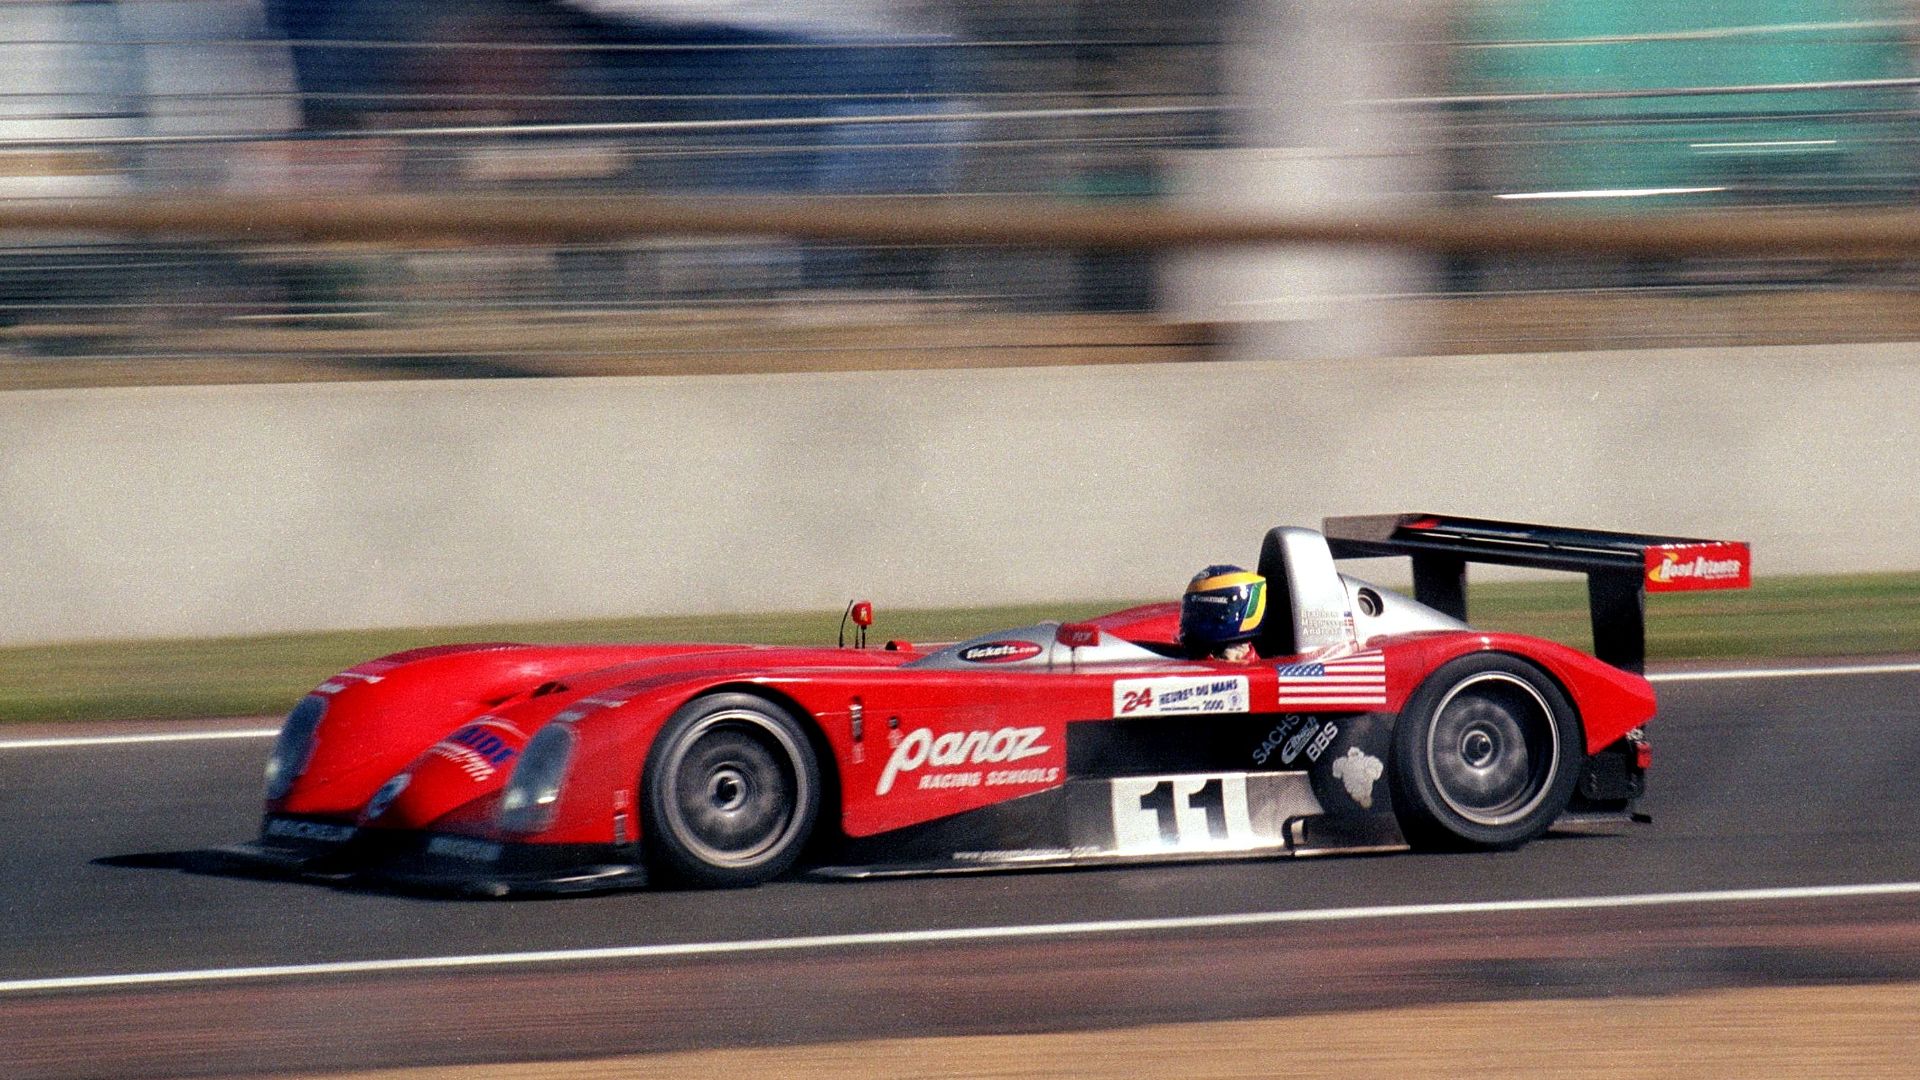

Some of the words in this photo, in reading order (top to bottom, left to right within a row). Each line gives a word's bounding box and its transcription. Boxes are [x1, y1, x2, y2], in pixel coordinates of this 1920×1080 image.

[1121, 687, 1153, 714] 24
[1196, 684, 1209, 696] DU
[1211, 679, 1238, 694] MANS
[1203, 699, 1224, 711] 2000
[1252, 713, 1300, 765] SACHS
[1306, 721, 1338, 762] BBS
[918, 771, 982, 790] RACING
[985, 767, 1060, 787] SCHOOLS
[1140, 778, 1229, 846] 11
